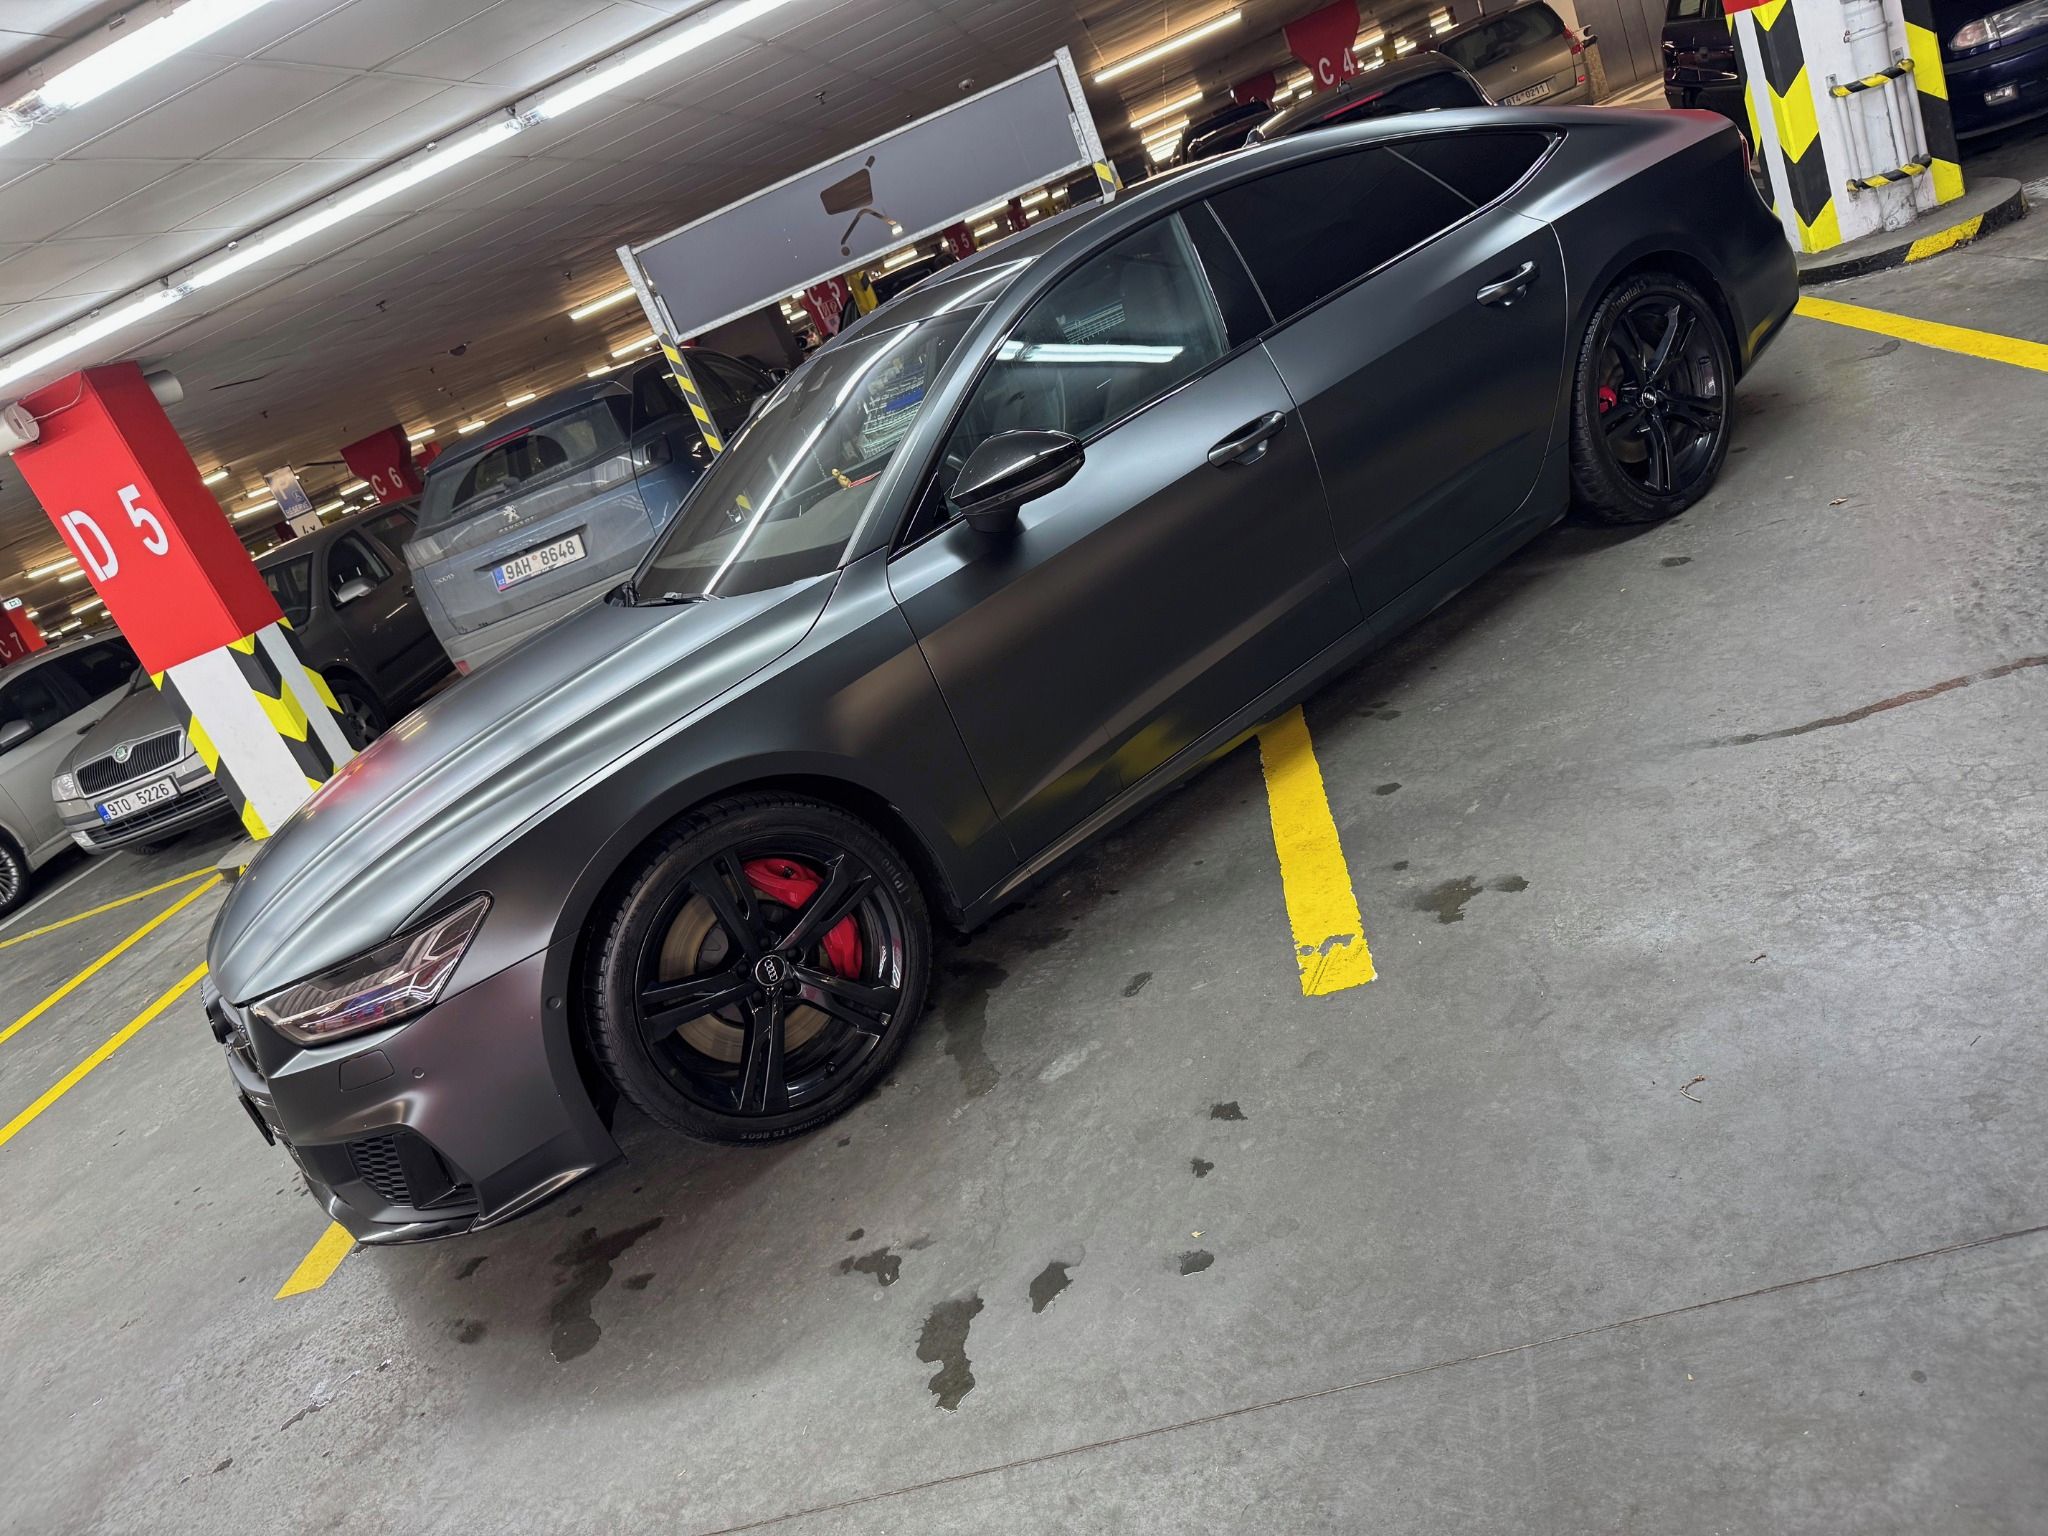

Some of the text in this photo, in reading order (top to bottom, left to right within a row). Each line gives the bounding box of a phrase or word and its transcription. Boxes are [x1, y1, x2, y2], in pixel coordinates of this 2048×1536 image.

[1319, 47, 1355, 85] C 4
[950, 232, 970, 254] B 5
[806, 279, 841, 306] C 5
[371, 466, 403, 496] C 6
[60, 483, 169, 583] D 5
[505, 557, 532, 580] 9AH
[540, 540, 576, 566] 8648
[9, 631, 24, 653] 7
[136, 783, 170, 805] 5226
